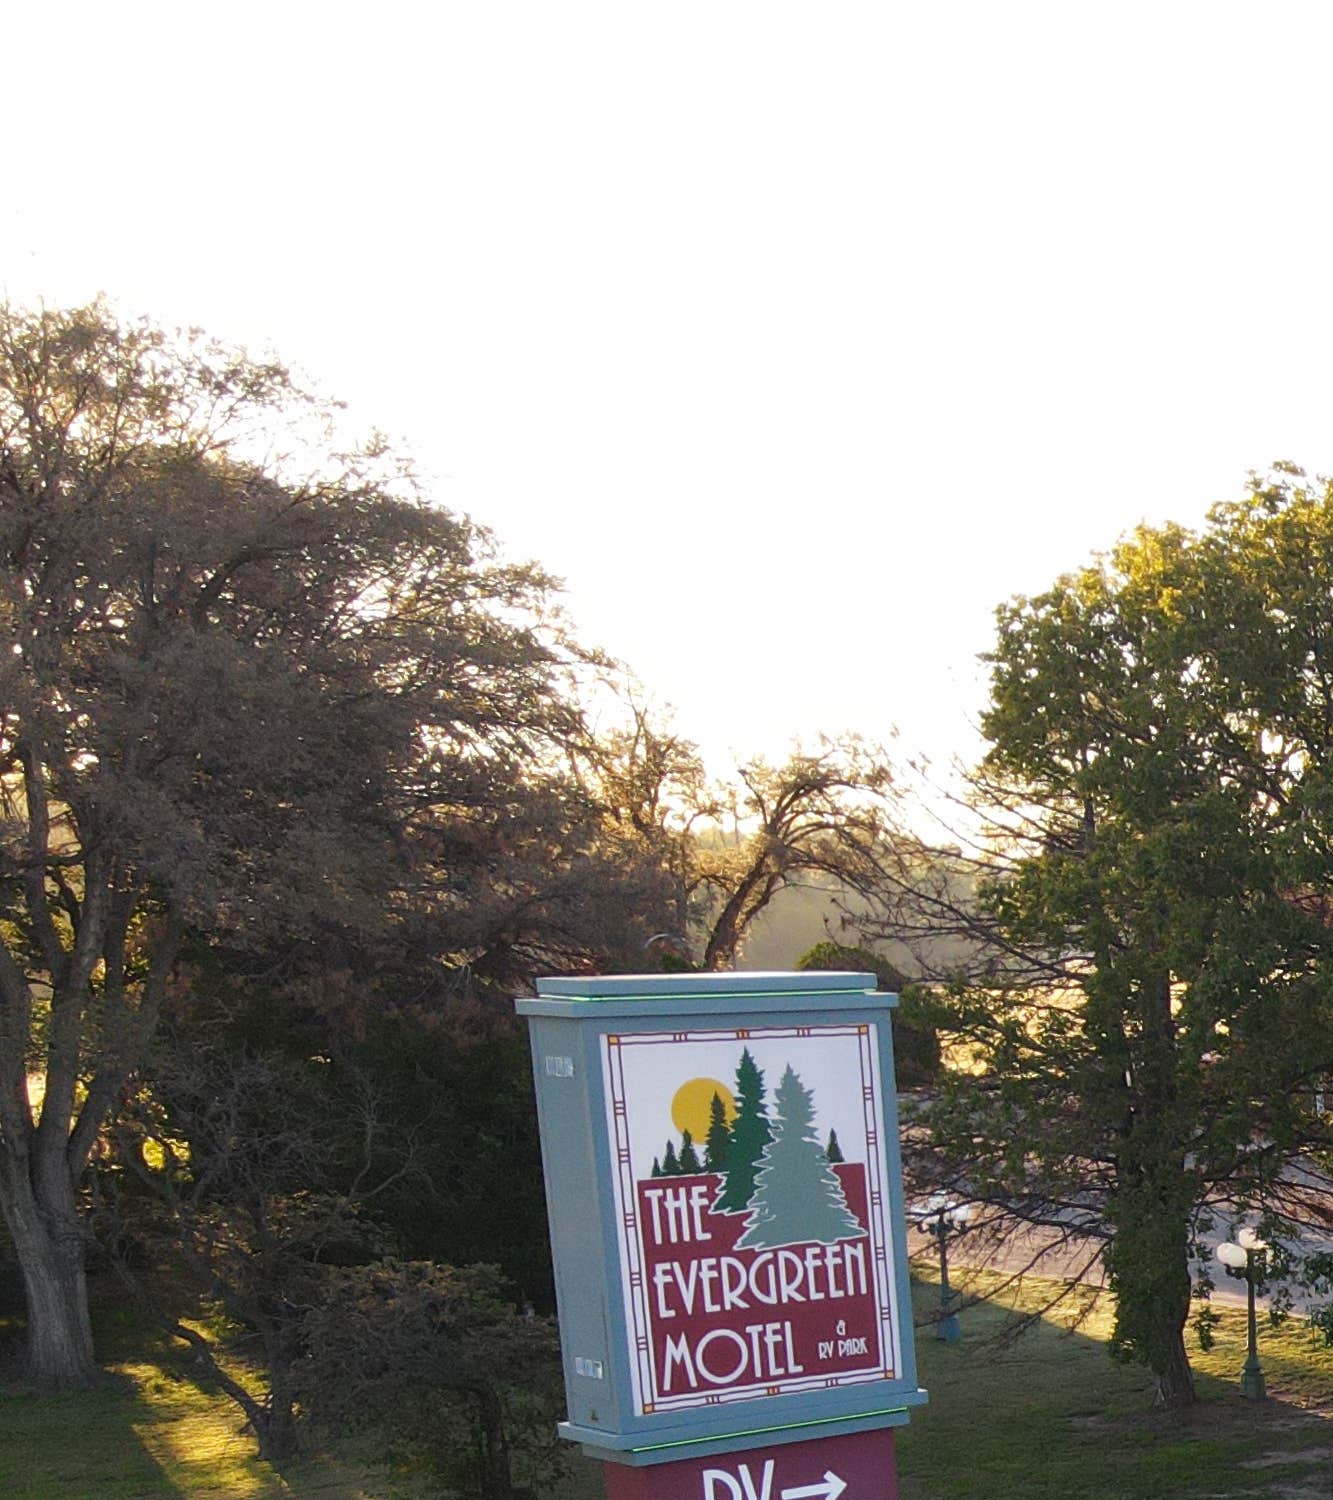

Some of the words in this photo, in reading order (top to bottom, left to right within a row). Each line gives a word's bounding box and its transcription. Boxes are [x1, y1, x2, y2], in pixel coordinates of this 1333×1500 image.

[644, 1185, 712, 1245] THE
[653, 1243, 868, 1318] EVERGREEN
[662, 1321, 804, 1391] MOTEL
[818, 1340, 834, 1359] RV
[838, 1337, 868, 1357] PARK
